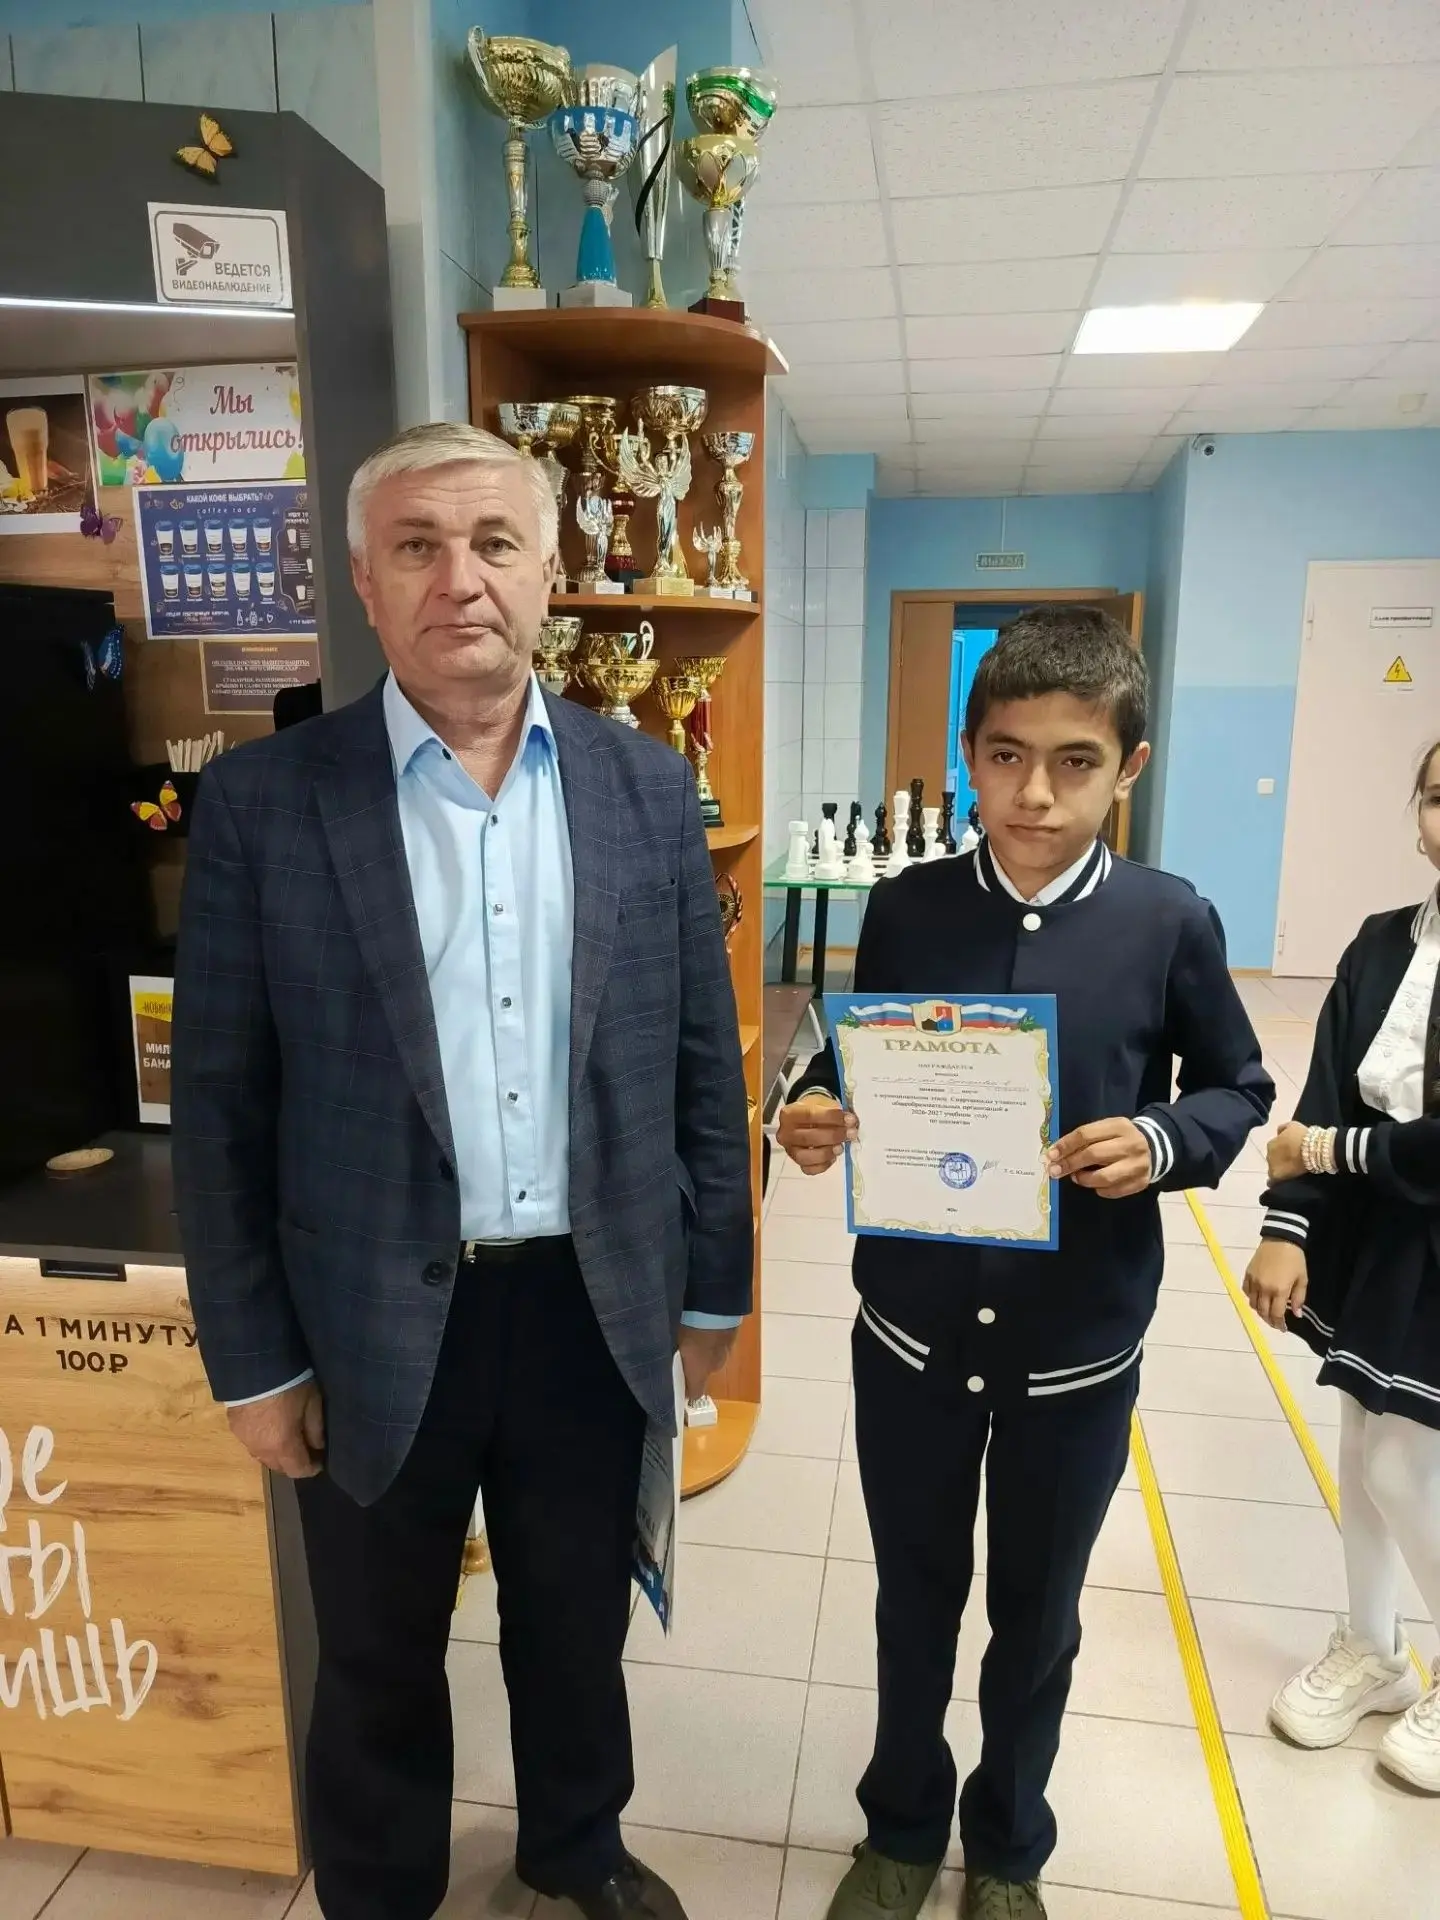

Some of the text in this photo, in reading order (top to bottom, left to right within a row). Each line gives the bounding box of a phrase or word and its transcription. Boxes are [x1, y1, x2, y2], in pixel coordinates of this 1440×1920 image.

[214, 262, 271, 277] ВЕДЕТСЯ
[172, 279, 272, 293] ВИДЕОНАБЛЮДЕНИЕ
[209, 385, 254, 415] Мы
[170, 427, 304, 463] открылись!
[186, 493, 208, 503] КАКОЙ
[208, 493, 228, 503] КОФЕ
[885, 1038, 1001, 1055] ГРАМОТА
[35, 1316, 47, 1338] 1
[60, 1317, 198, 1349] МИНУТУ
